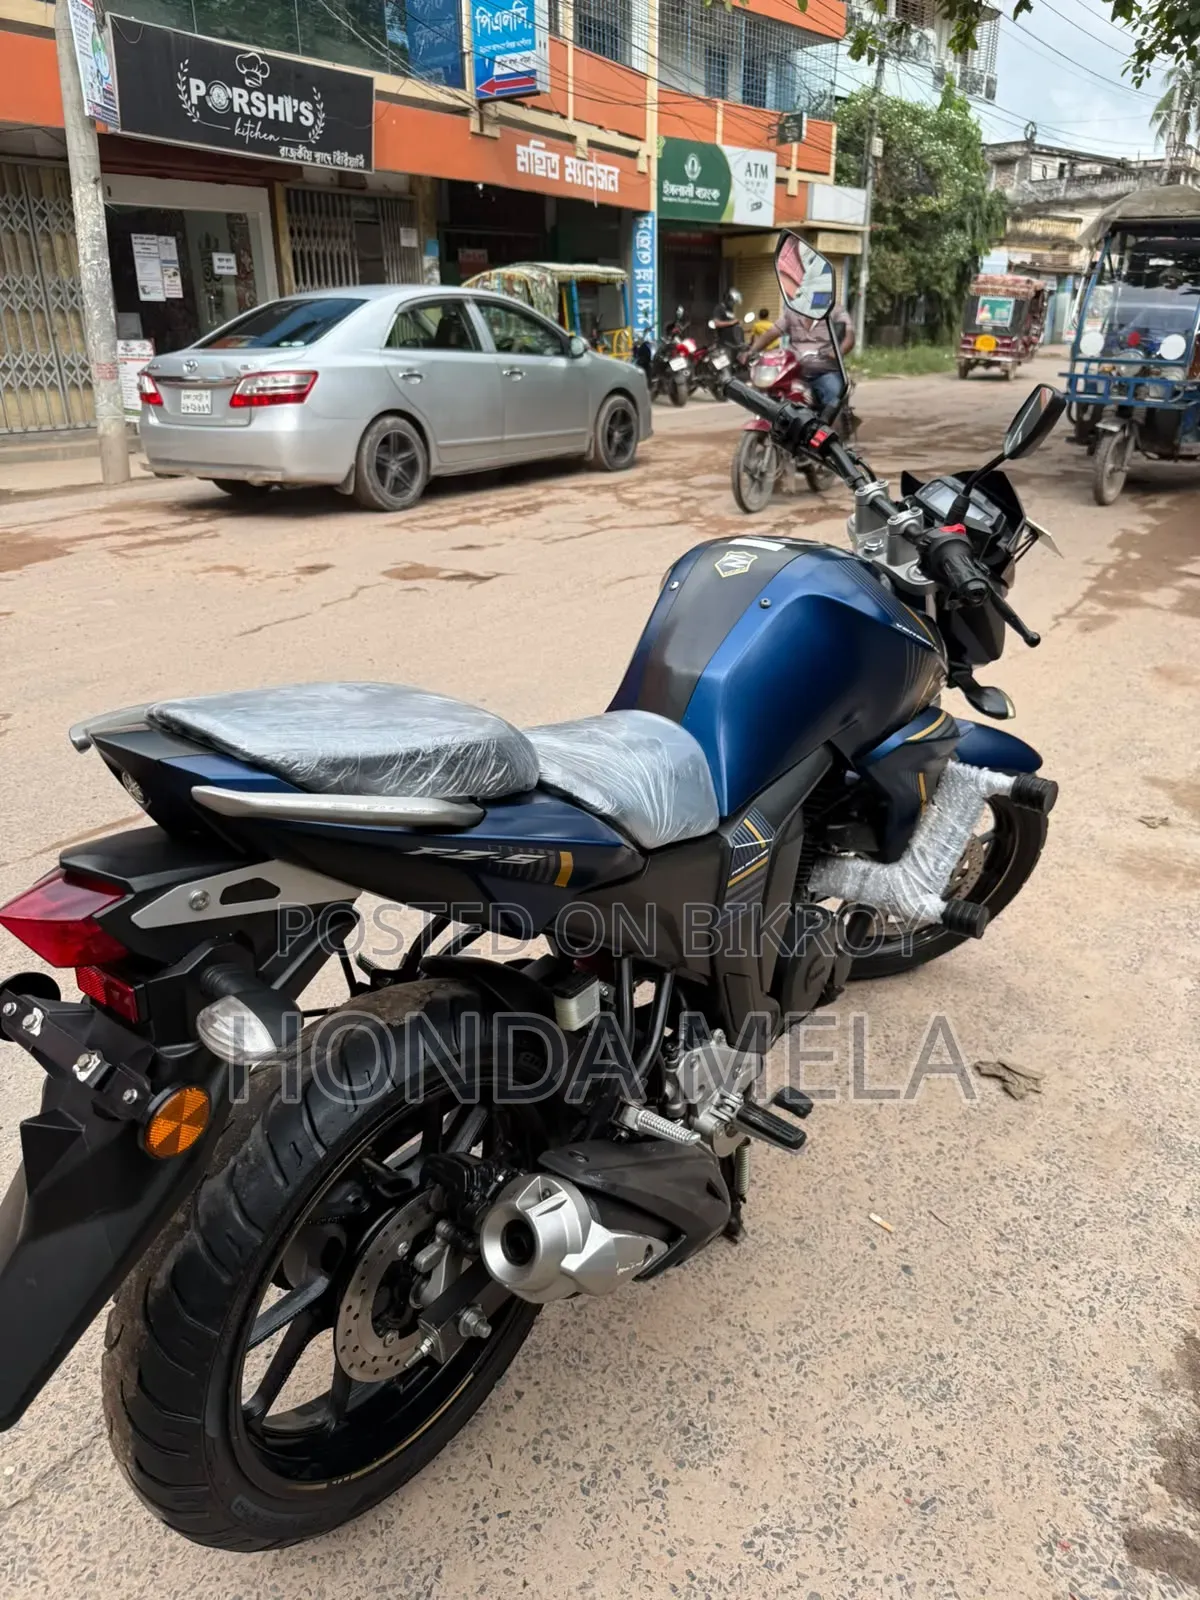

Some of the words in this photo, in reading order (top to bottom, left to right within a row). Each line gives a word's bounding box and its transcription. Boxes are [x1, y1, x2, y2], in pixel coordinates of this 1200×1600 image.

[234, 117, 280, 144] kitchen
[744, 162, 769, 179] ATM
[662, 180, 694, 198] ইসলামী
[695, 186, 720, 200] ব্যাংক
